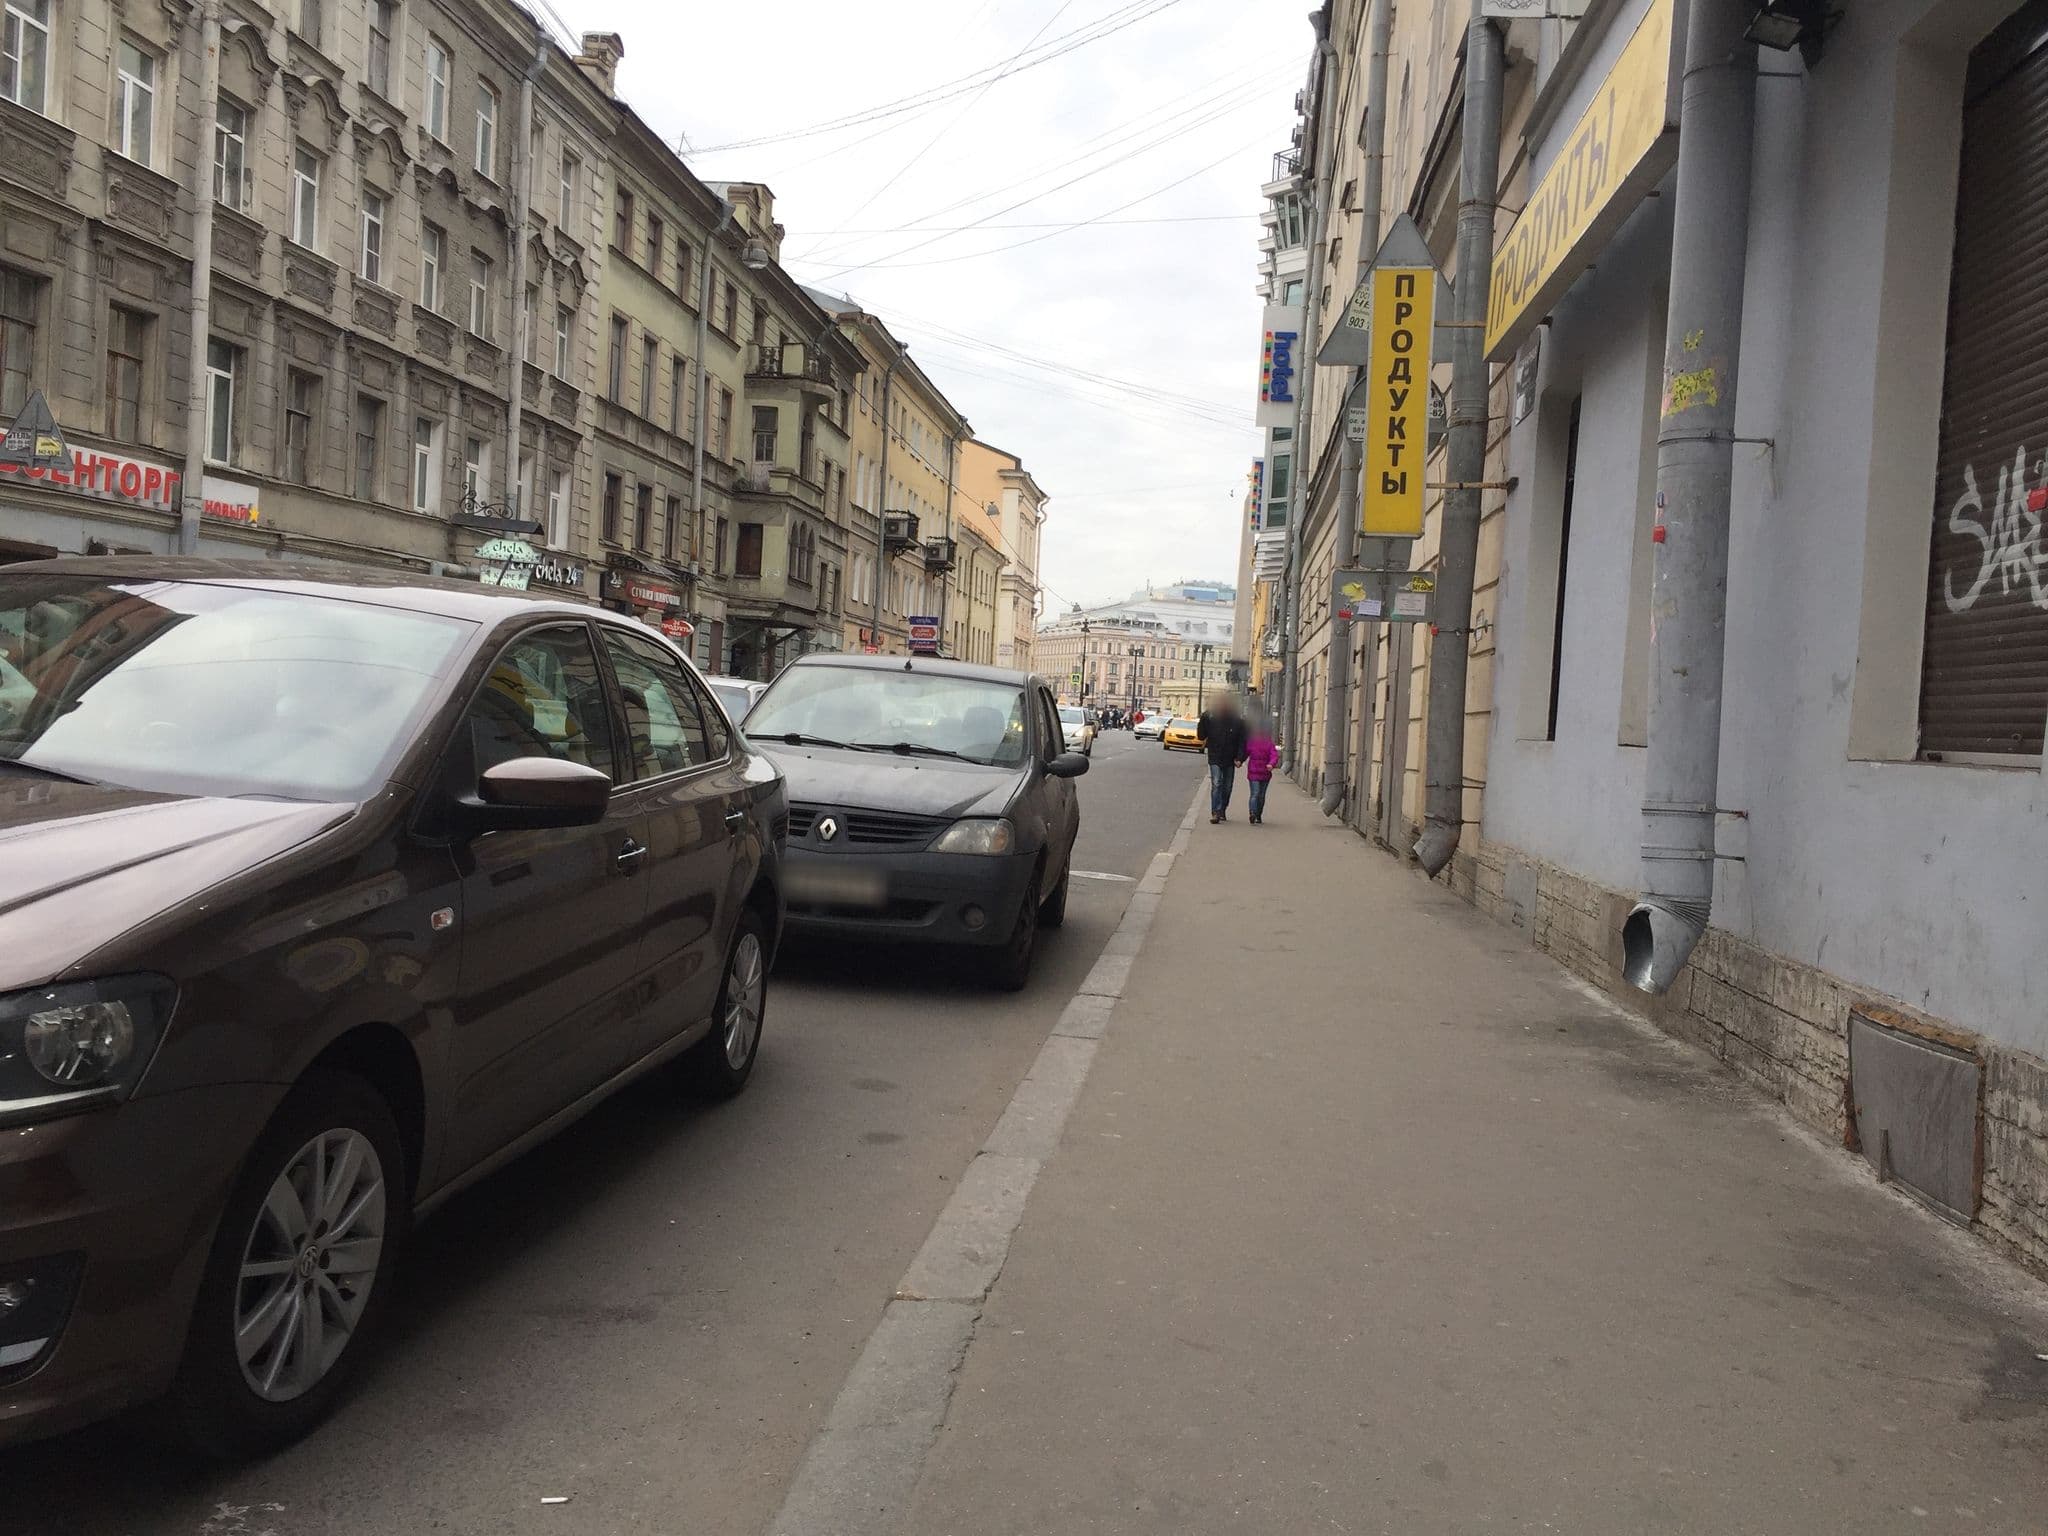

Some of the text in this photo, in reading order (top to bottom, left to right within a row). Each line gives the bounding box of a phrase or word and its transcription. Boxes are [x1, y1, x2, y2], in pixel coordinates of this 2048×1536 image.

[1488, 87, 1616, 339] ПРОДУКТЫ
[1270, 331, 1298, 403] hotel
[1348, 316, 1365, 329] 903
[1381, 274, 1415, 495] ПРОДУКТЫ
